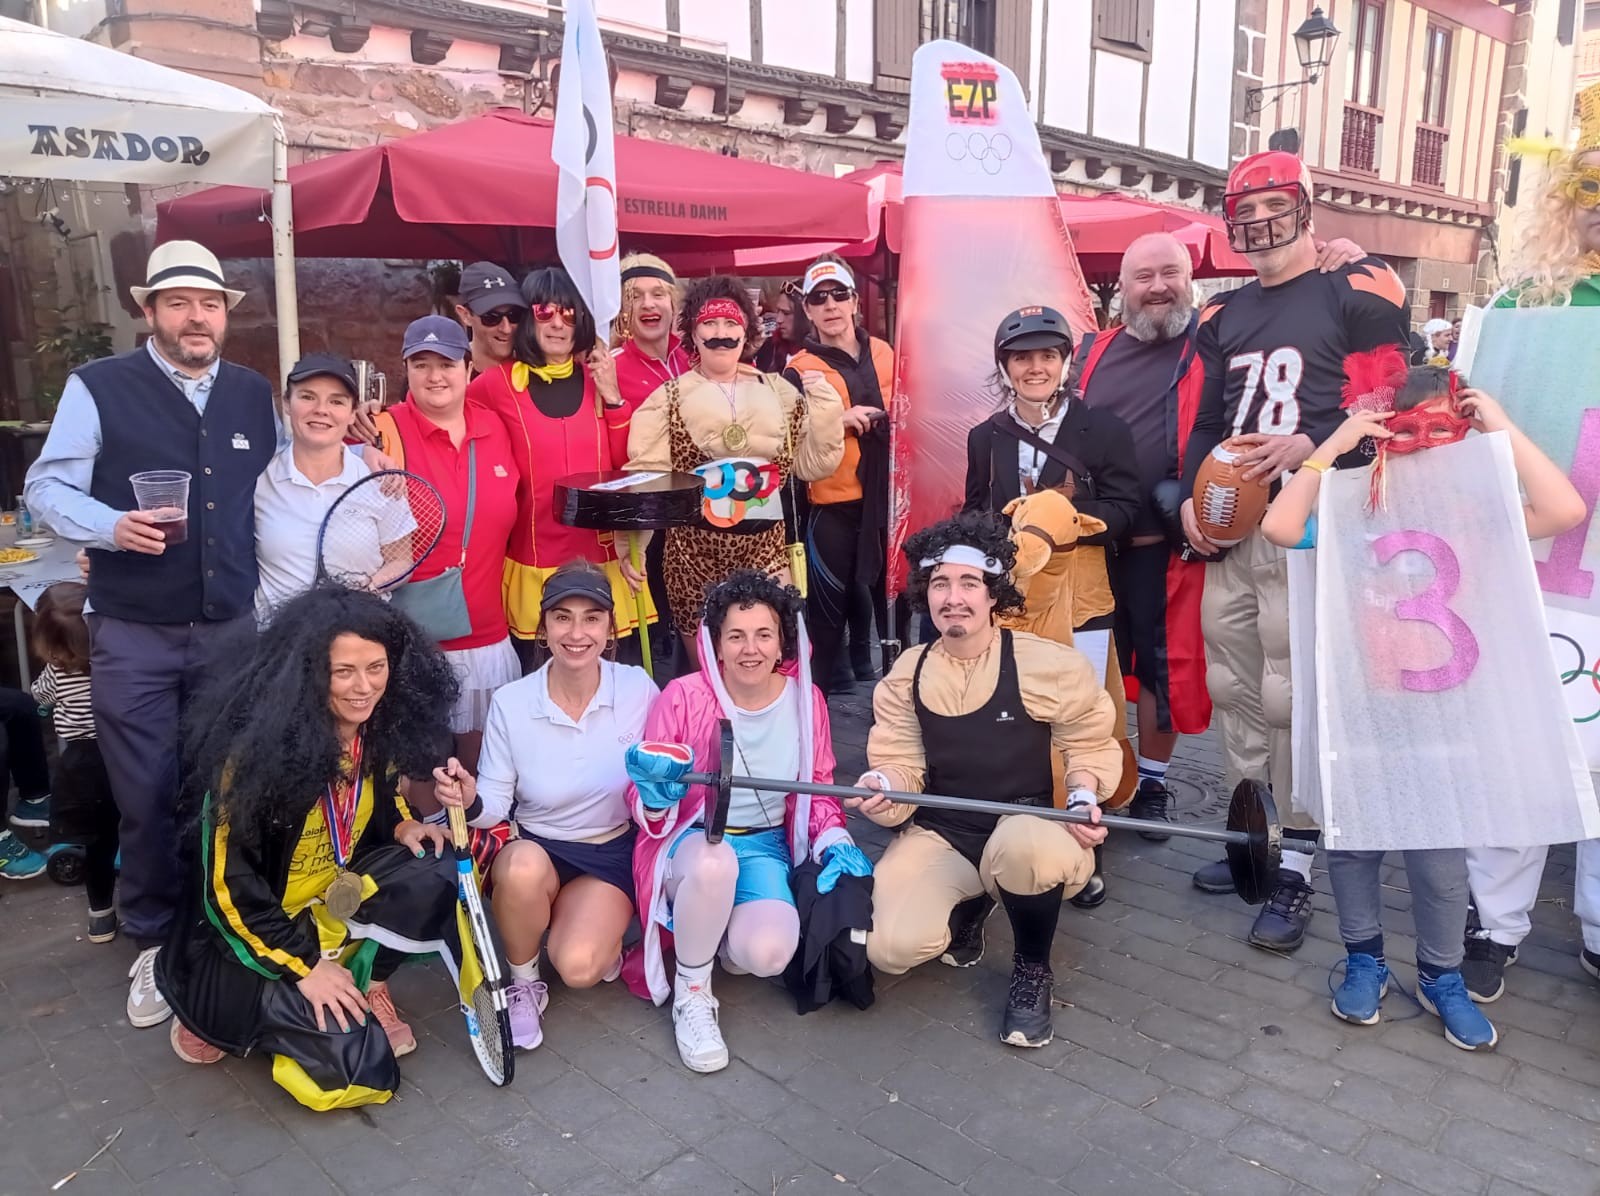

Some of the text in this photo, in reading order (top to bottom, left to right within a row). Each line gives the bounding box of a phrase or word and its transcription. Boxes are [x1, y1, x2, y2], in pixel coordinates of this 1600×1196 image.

[946, 78, 997, 119] EZP
[28, 124, 210, 166] ASADOR
[624, 197, 686, 218] ESTRELLA
[690, 203, 728, 221] DAMM
[1229, 346, 1304, 438] 78
[1371, 529, 1480, 693] 3
